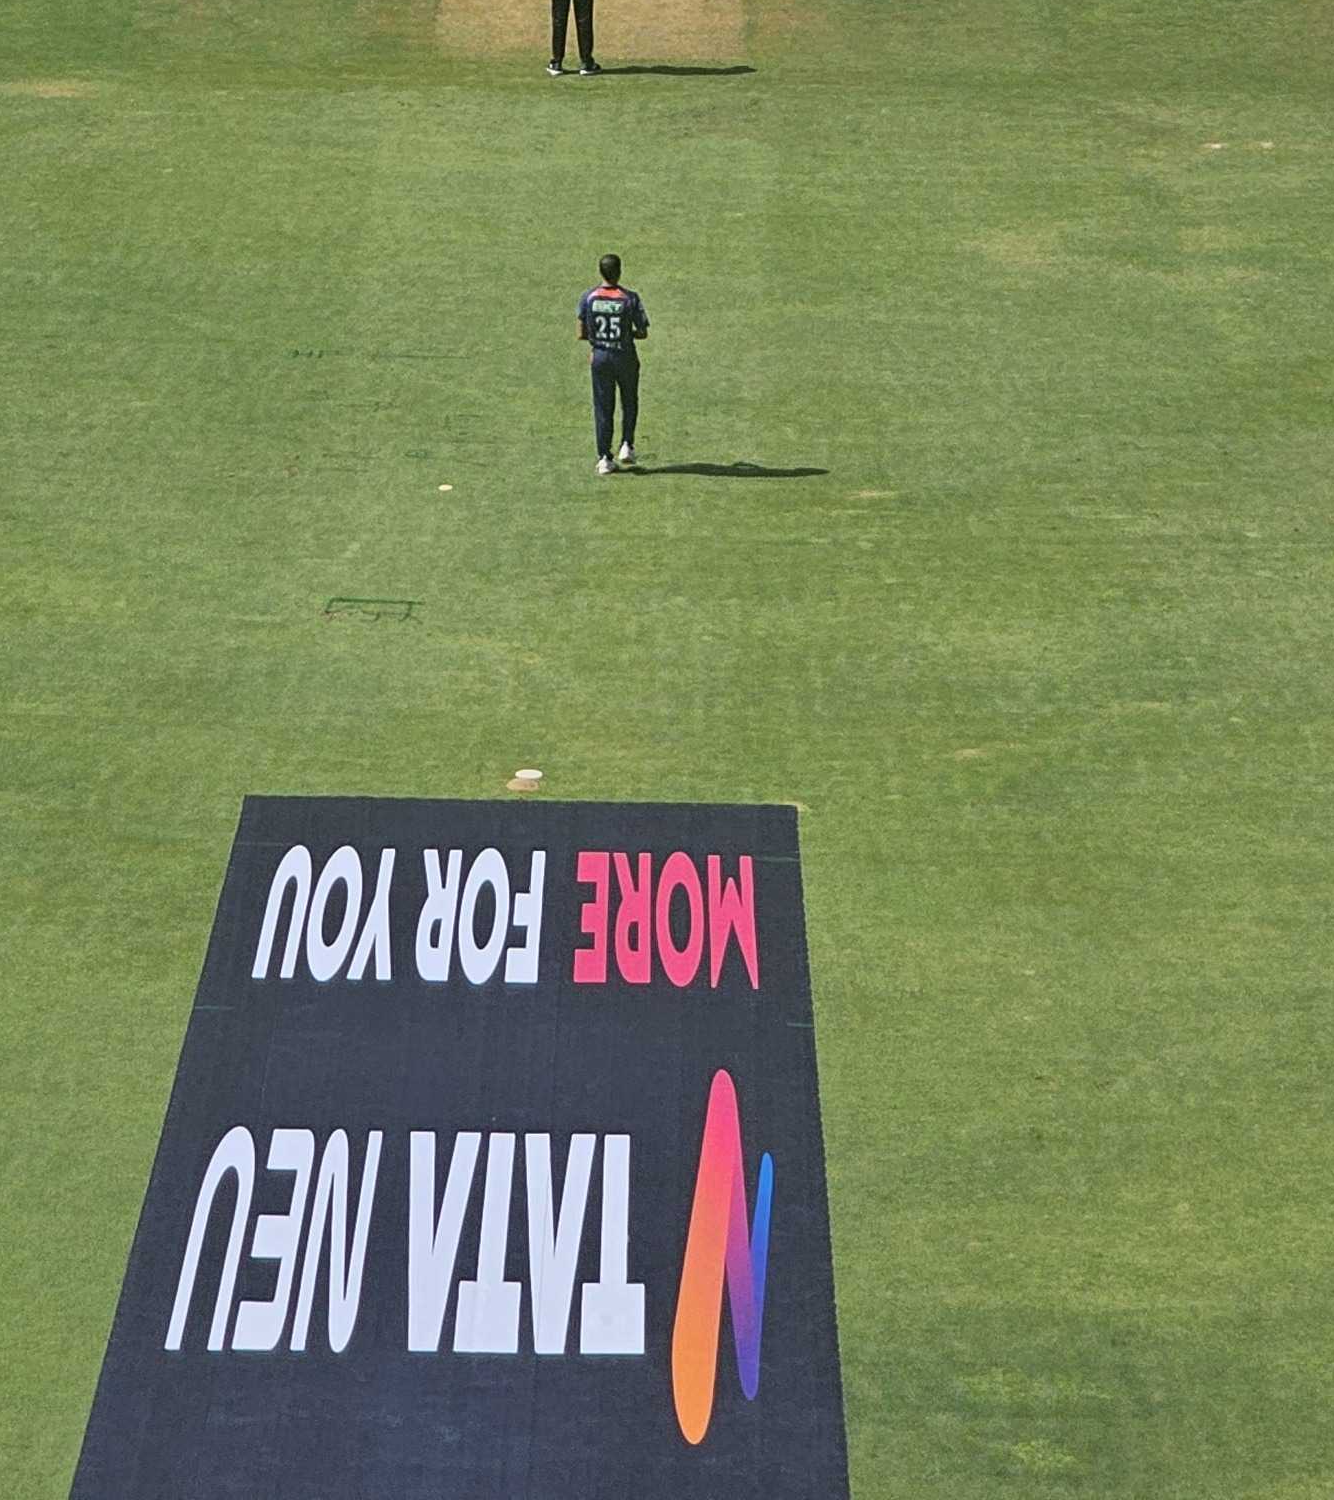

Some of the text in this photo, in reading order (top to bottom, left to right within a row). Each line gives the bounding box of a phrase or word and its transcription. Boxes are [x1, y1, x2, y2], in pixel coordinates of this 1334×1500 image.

[595, 316, 621, 340] 25
[250, 844, 760, 991] MORE FOR YOU
[164, 1125, 646, 1356] TATA NEU
